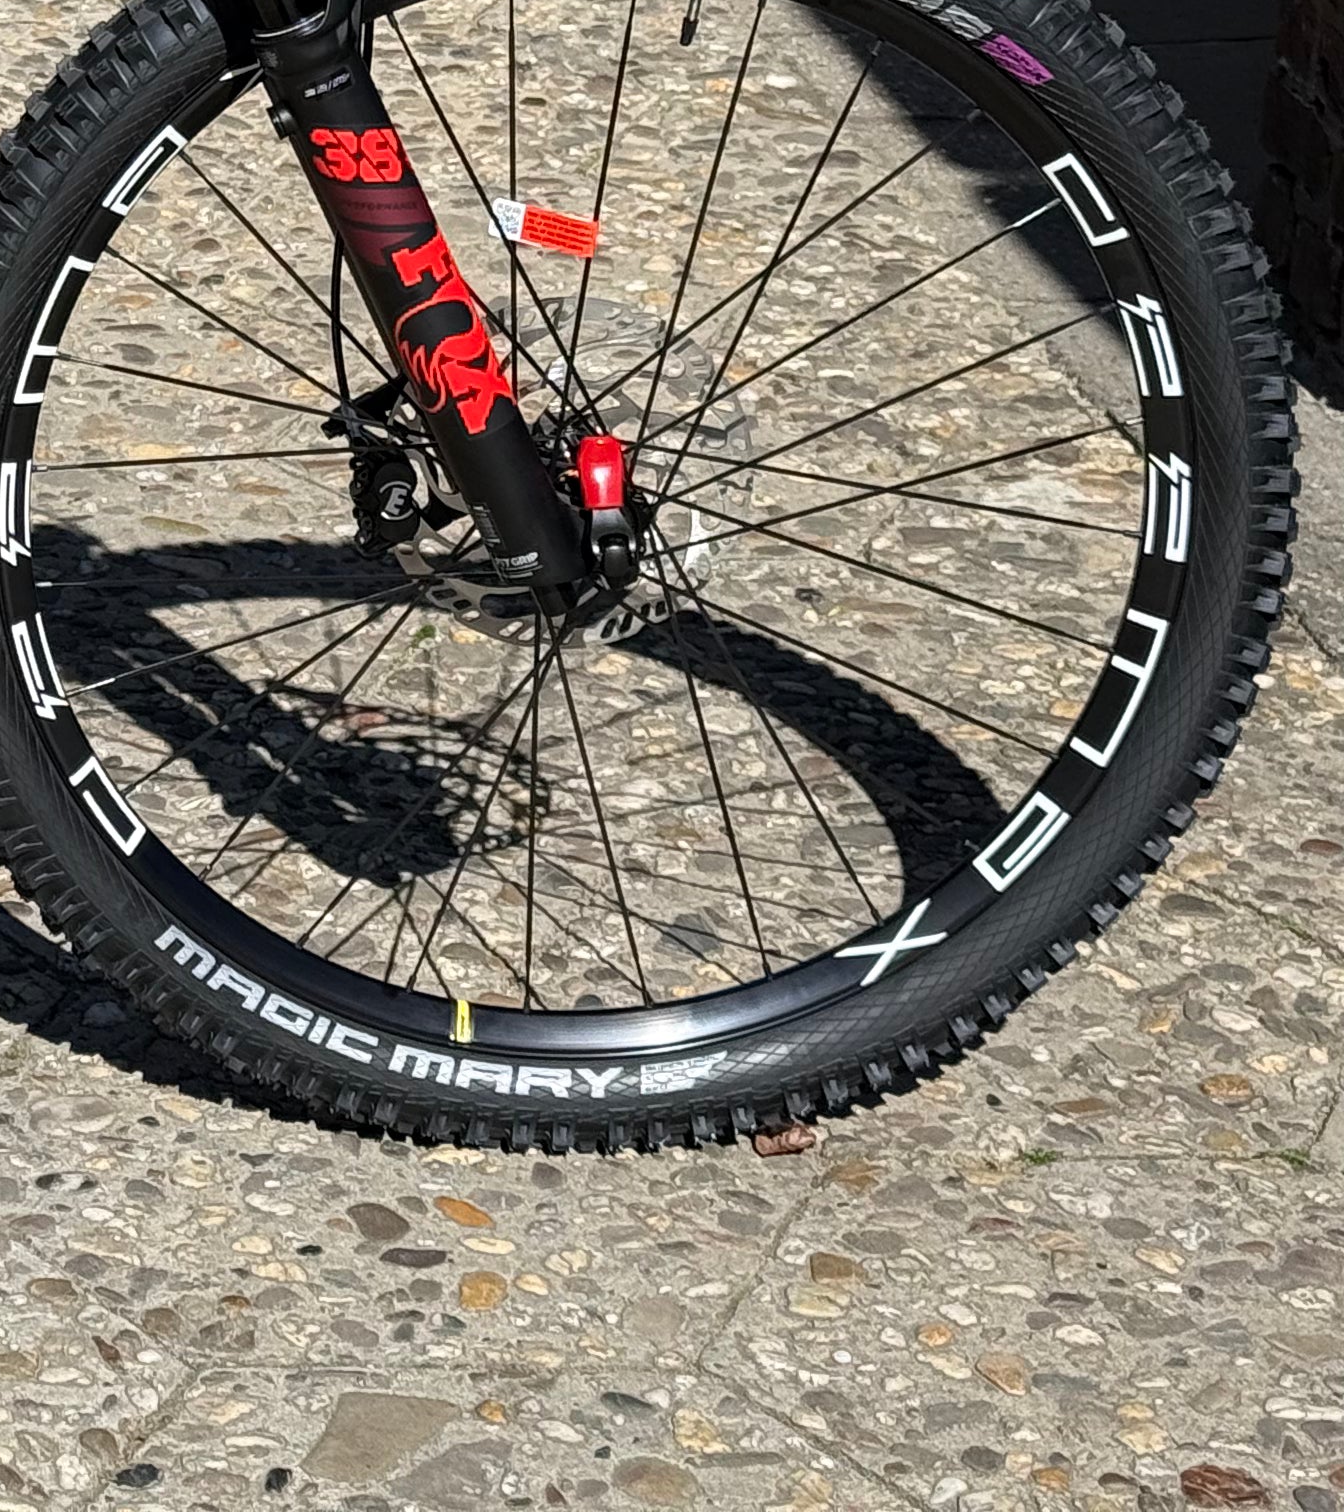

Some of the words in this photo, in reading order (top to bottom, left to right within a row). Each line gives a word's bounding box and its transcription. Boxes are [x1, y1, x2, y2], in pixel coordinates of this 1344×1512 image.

[391, 230, 517, 434] FOX
[154, 925, 382, 1064] MAGIC
[388, 1044, 623, 1100] MARY
